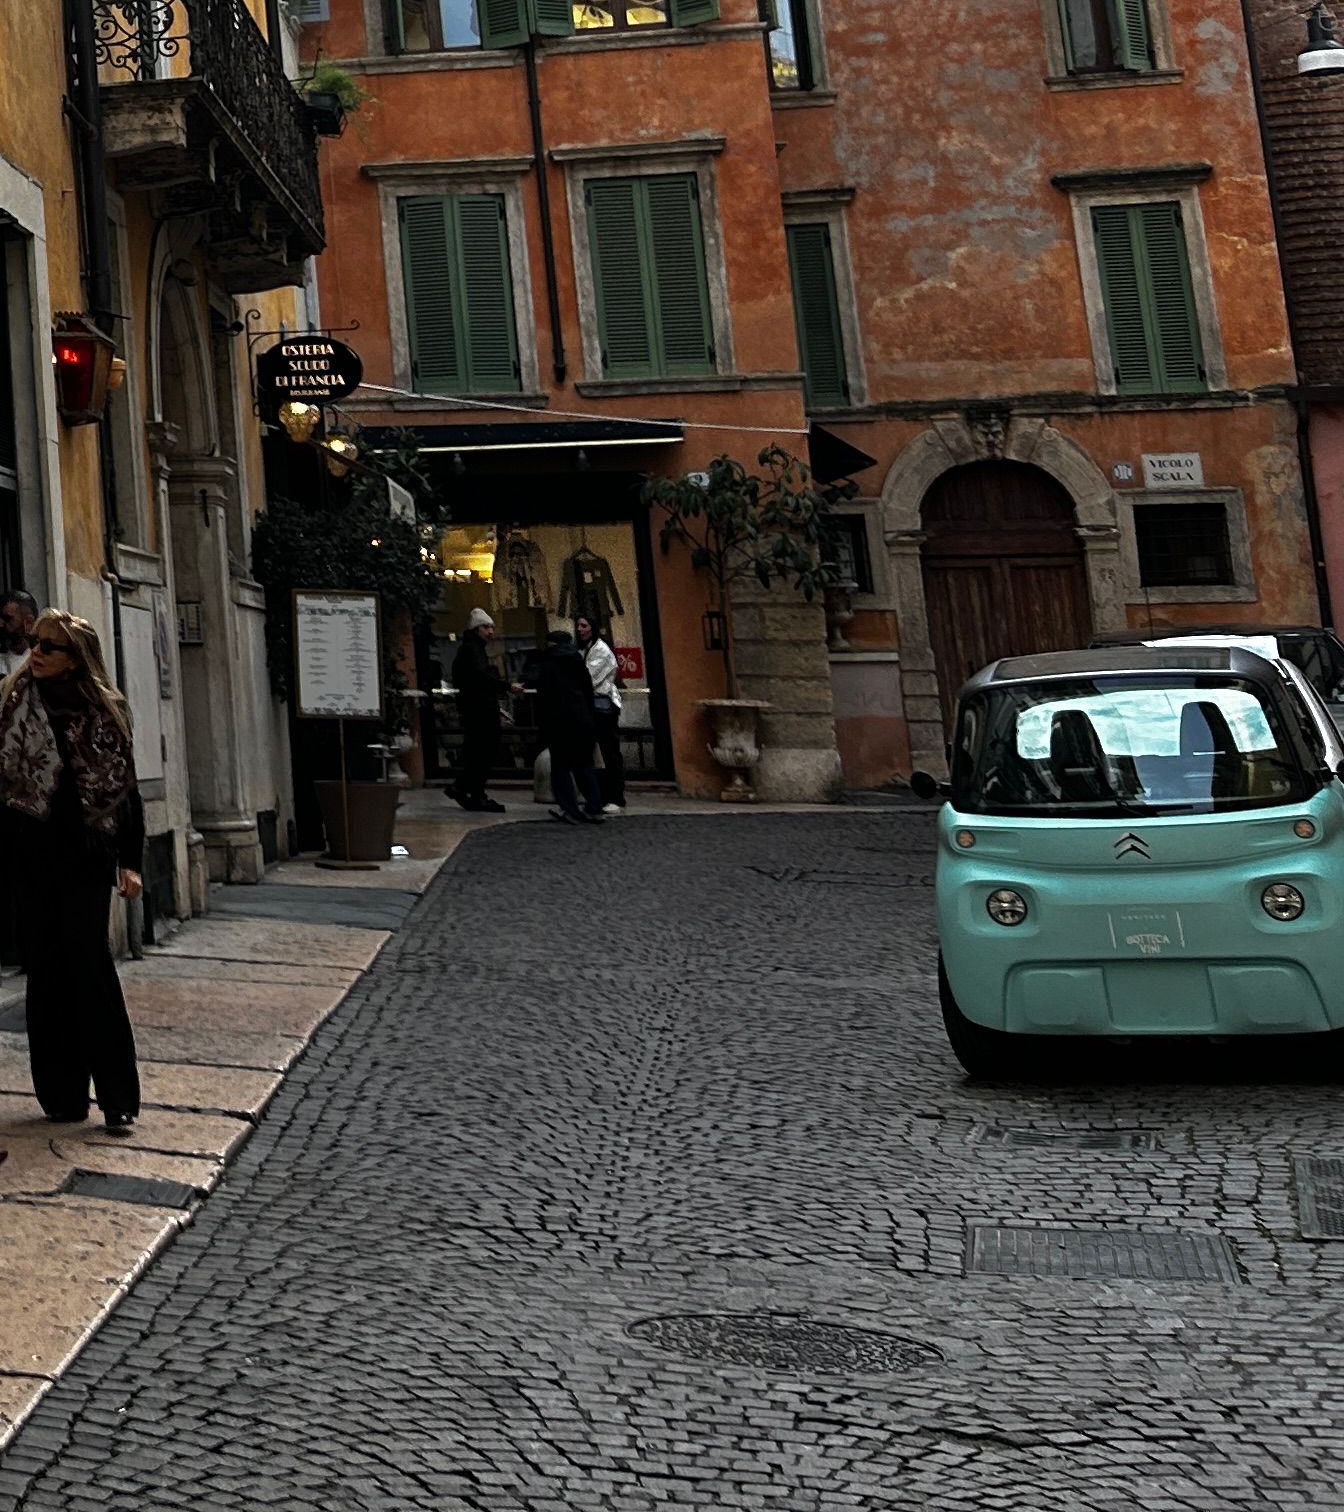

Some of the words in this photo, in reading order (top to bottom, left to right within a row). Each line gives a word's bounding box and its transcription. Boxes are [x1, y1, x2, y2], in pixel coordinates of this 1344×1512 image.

[281, 344, 335, 356] OSTERIA
[288, 359, 330, 371] SCUDO
[275, 376, 289, 387] DI
[291, 374, 346, 386] FRANCIA
[1149, 458, 1194, 469] VICOLO
[1152, 472, 1194, 482] SCALA
